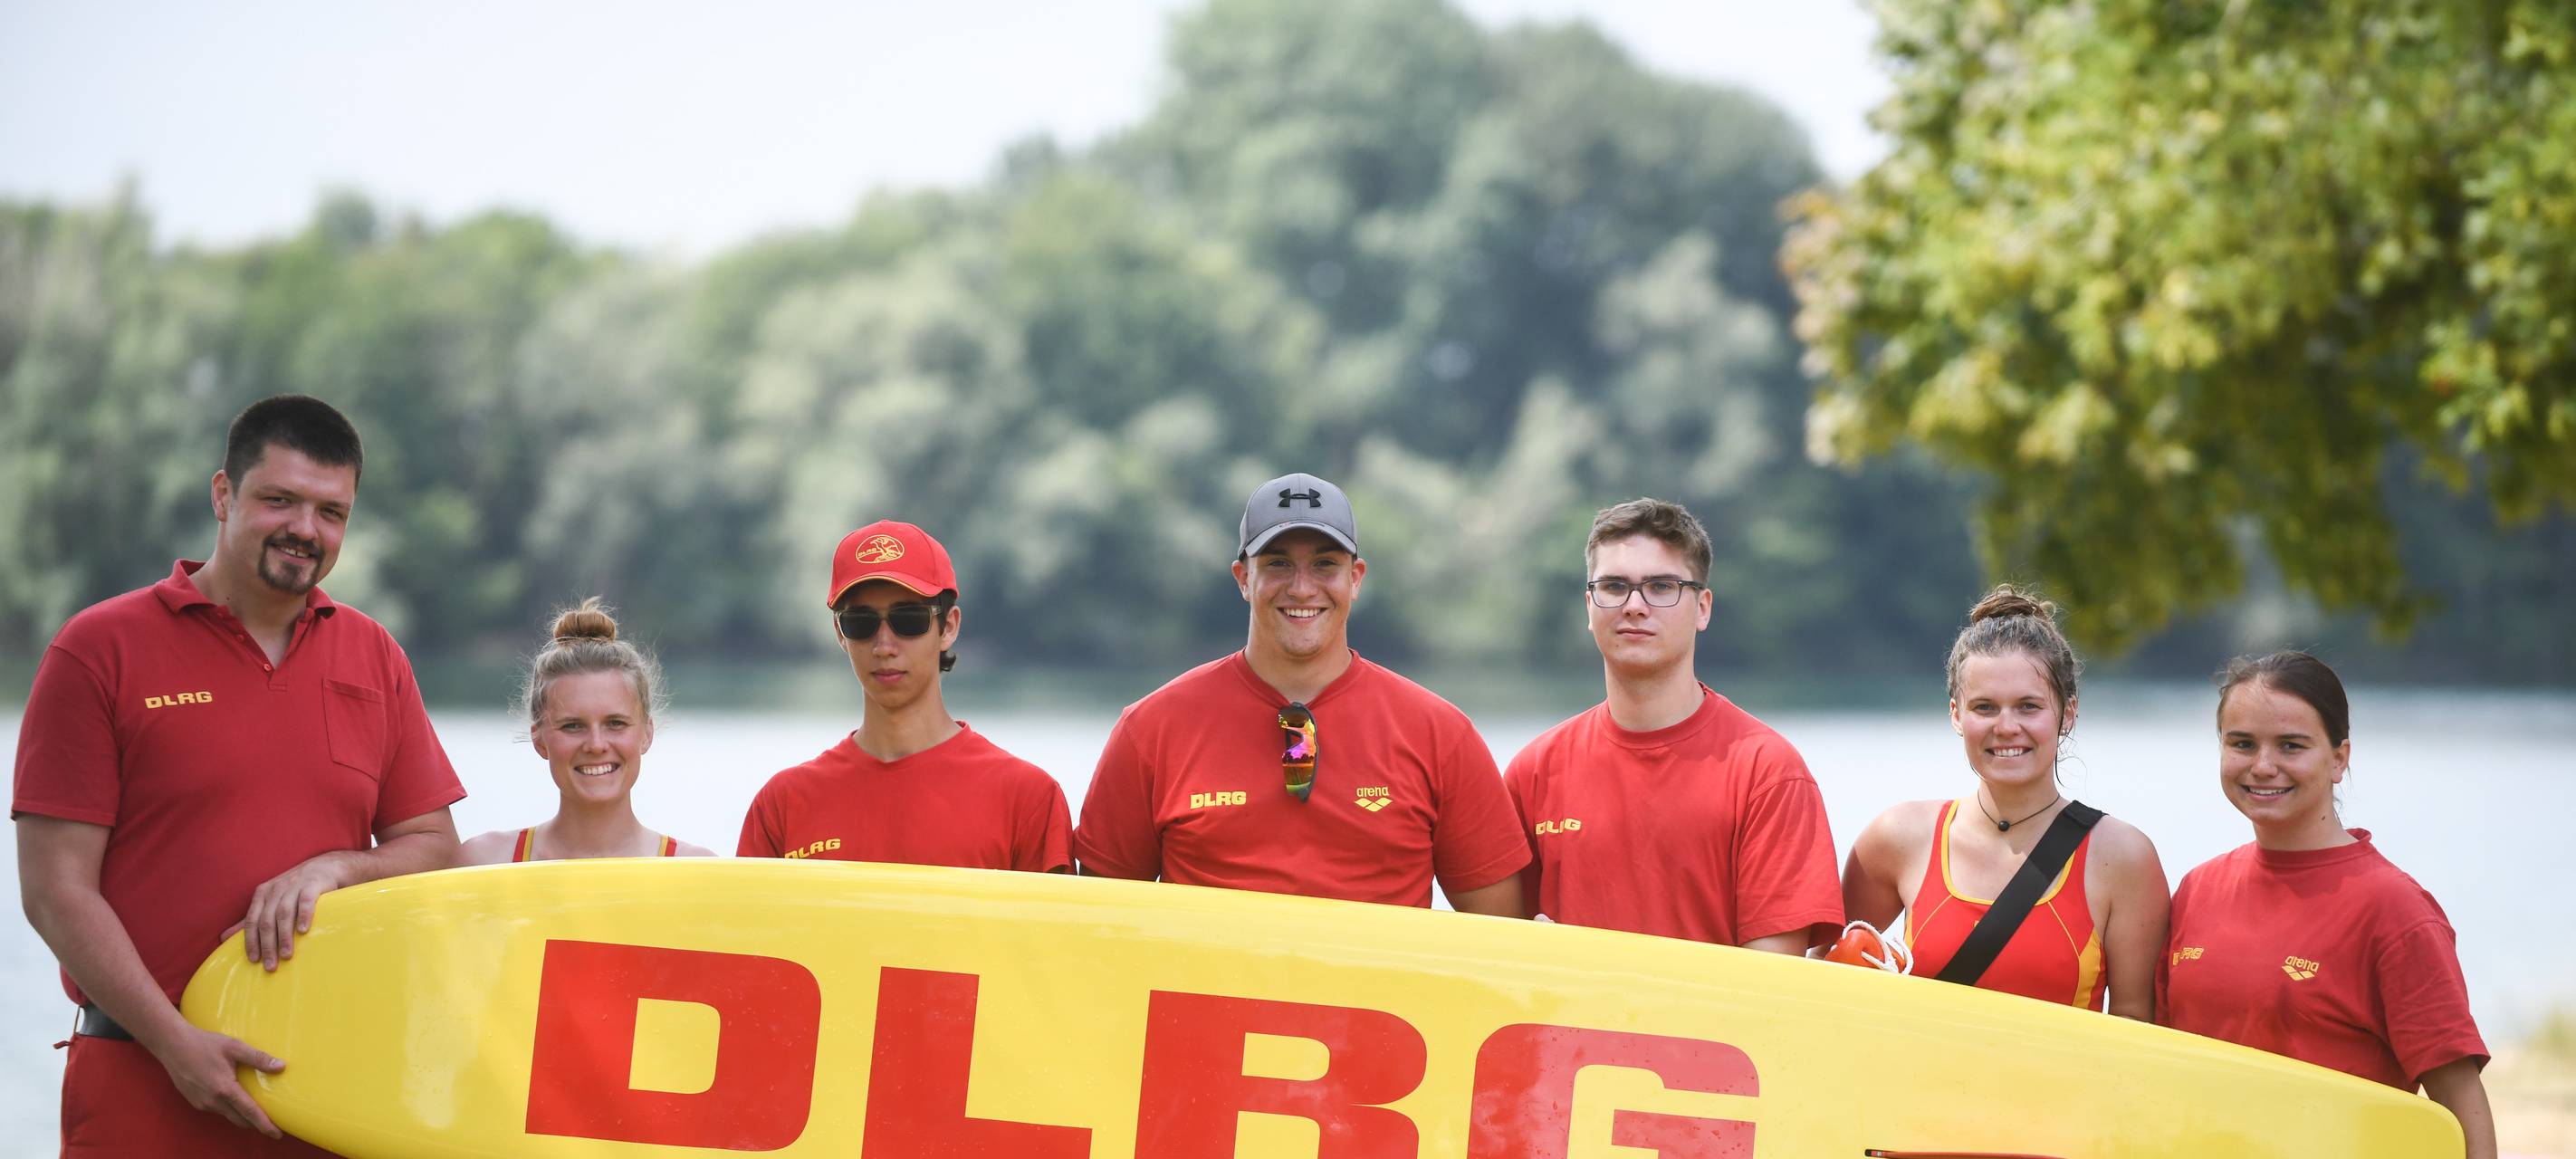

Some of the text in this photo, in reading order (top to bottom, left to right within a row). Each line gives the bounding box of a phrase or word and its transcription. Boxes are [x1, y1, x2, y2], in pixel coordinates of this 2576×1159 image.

[145, 691, 213, 709] DLRG
[1190, 791, 1247, 809] DLRG
[1356, 786, 1390, 797] arena
[2284, 955, 2320, 973] arena
[525, 939, 1761, 1159] DLRG
